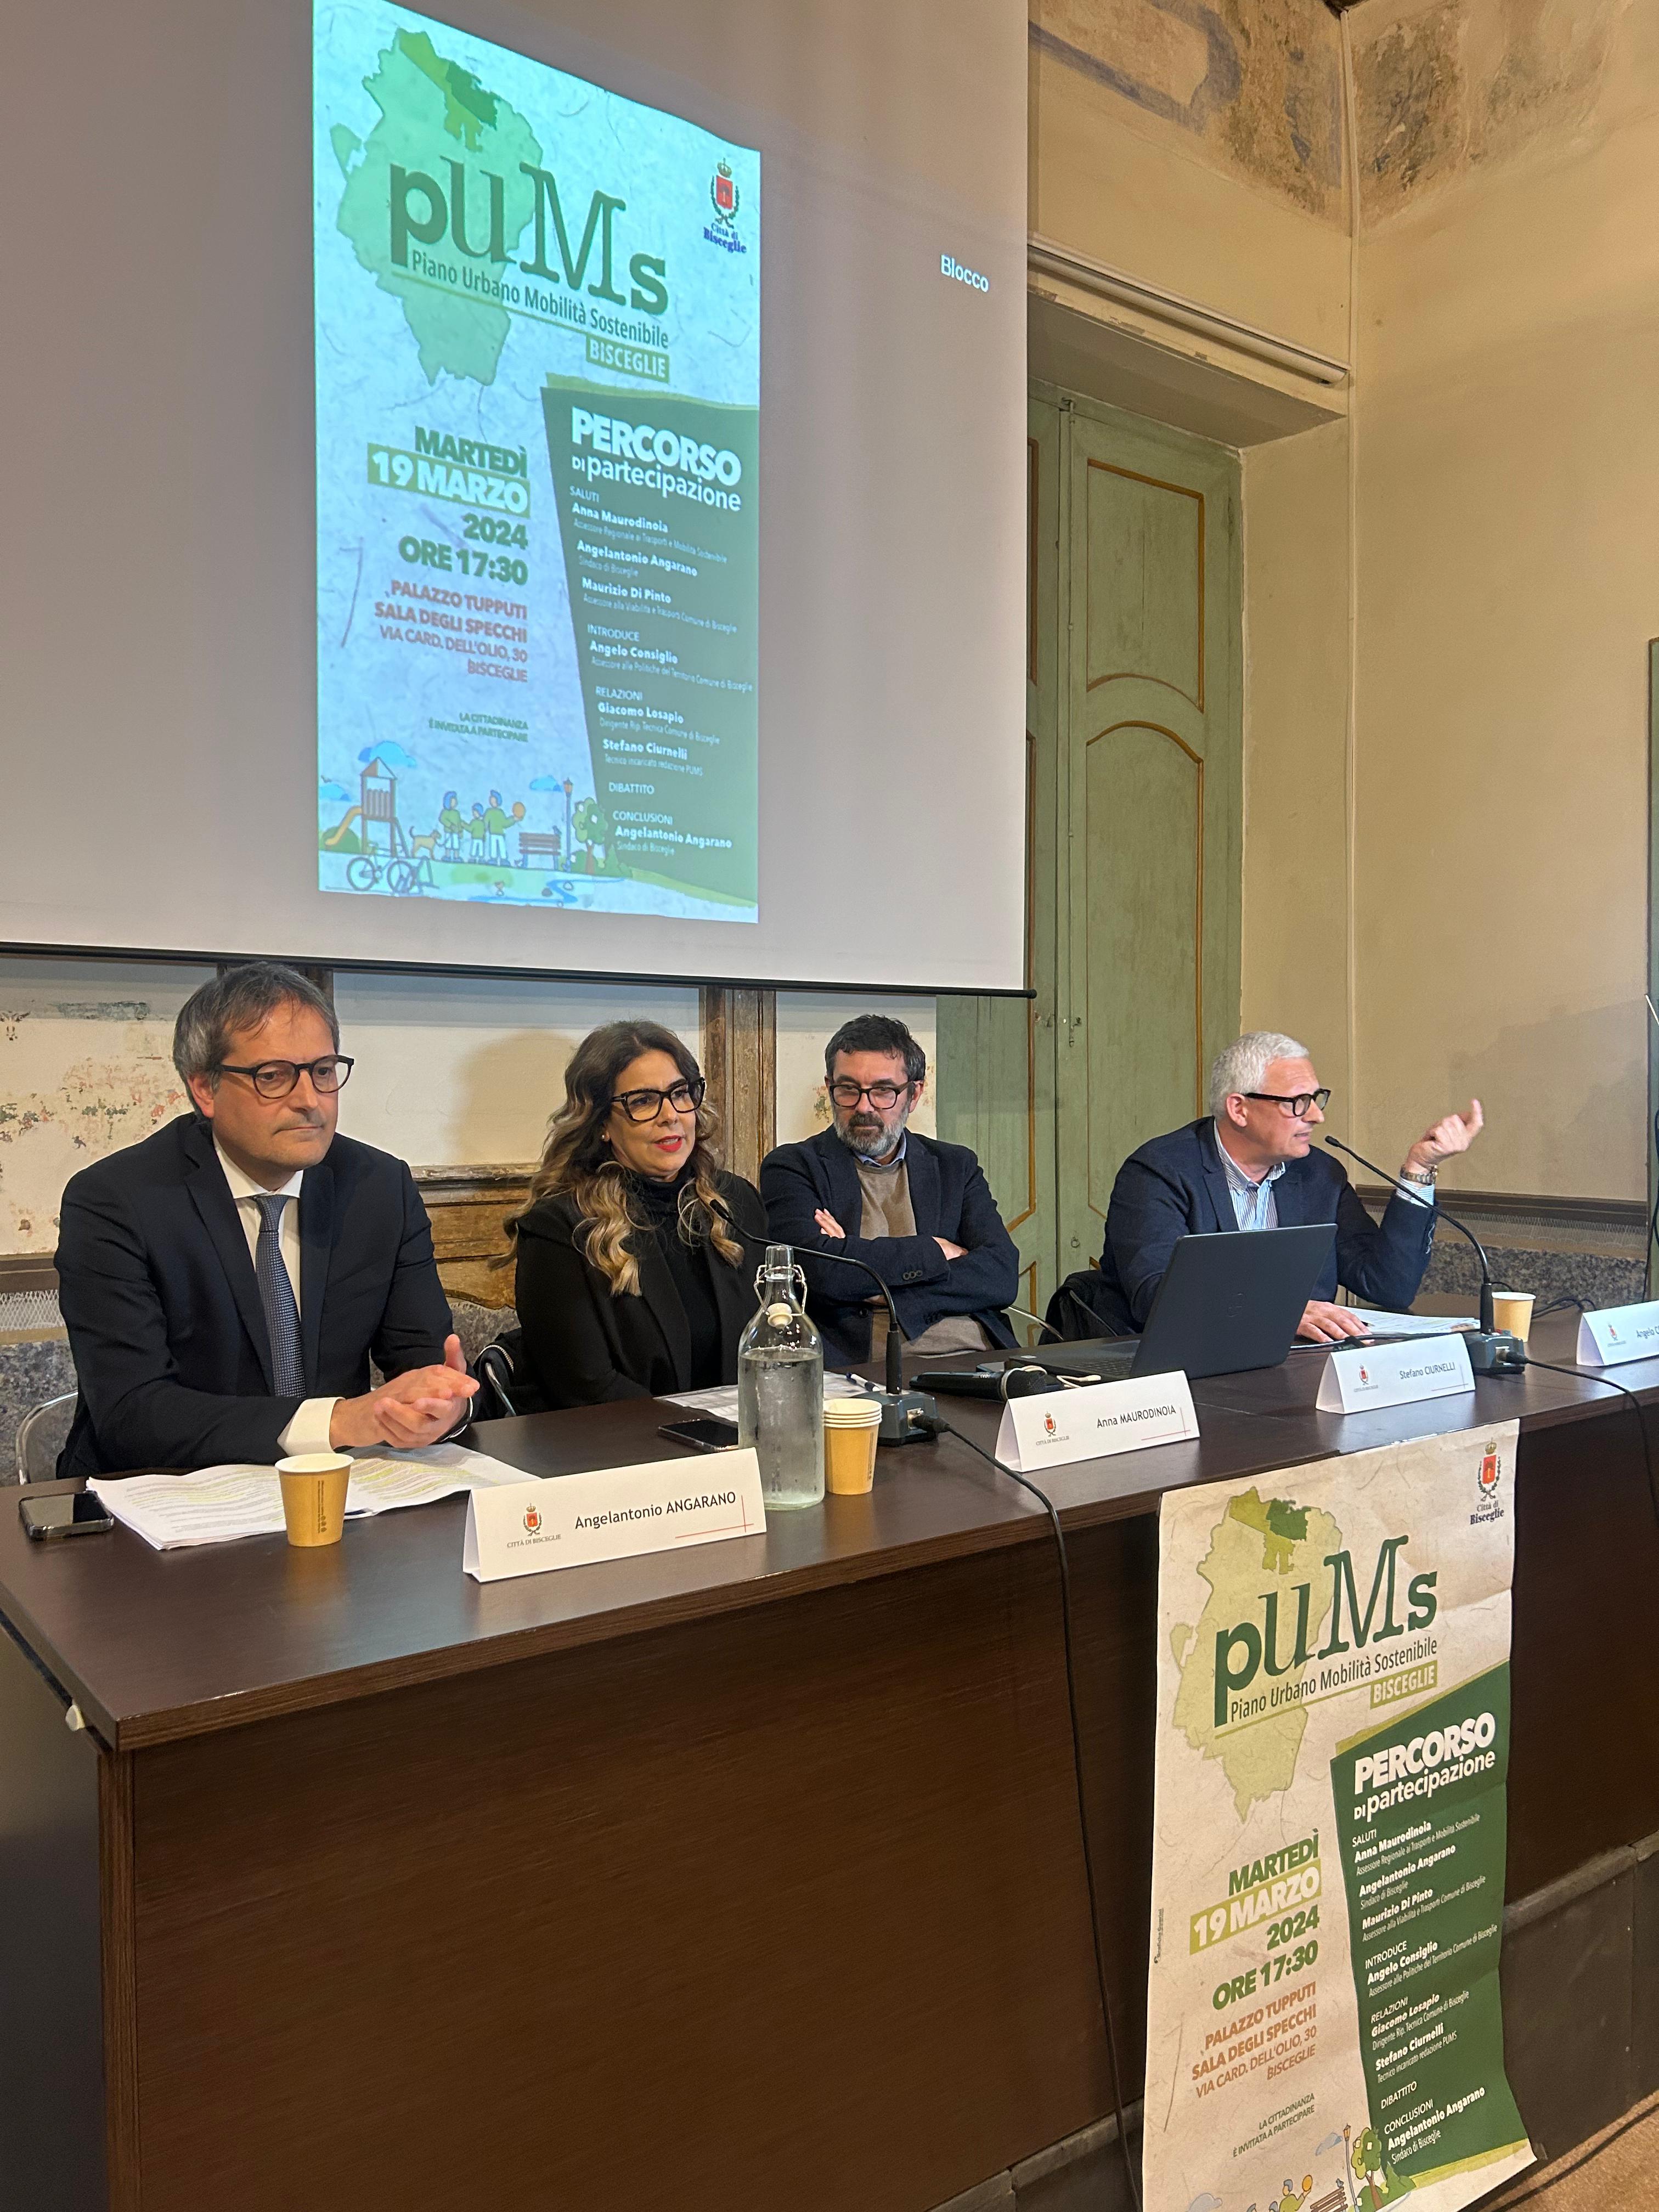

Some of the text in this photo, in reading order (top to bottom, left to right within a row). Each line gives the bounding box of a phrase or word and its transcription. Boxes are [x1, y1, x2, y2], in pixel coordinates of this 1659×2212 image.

[941, 255, 989, 292] Blocco
[413, 250, 669, 349] Piano Urbano Mobilità Sostenibile
[590, 338, 665, 379] BISCEGLIE
[415, 426, 527, 478] MARTEDÌ
[572, 407, 741, 486] PERCORSO
[373, 452, 528, 513] 19 MARZO
[569, 486, 599, 503] SALUTI
[588, 455, 741, 511] partecipazione
[463, 513, 528, 549] 2024
[572, 503, 668, 533] Anna Maurodinoia
[398, 535, 528, 585] ORE 17:30
[577, 540, 648, 564] Angelantonio
[651, 555, 697, 576] Angarano
[391, 579, 527, 620] PALAZZO TUPPUTI
[582, 577, 672, 603] Maurizio Di Pinto
[375, 601, 527, 643] SALA DEGLI SPECCHI
[588, 624, 639, 641] INTRODUCE
[380, 625, 403, 641] VIA
[512, 648, 527, 663] 30
[590, 640, 678, 664] Angelo Consiglio
[468, 658, 527, 682] BISCEGLIE
[596, 686, 643, 701] RELAZIONI
[598, 702, 684, 724] Giacomo Losapio
[603, 739, 687, 760] Stefano Ciurnelli
[608, 782, 654, 794] DIBATTITO
[613, 811, 673, 825] CONCLUSIONI
[616, 826, 732, 849] Angelantonio Angarano
[1637, 1328, 1655, 1339] Angelo
[1400, 1362, 1455, 1379] Stefano CIURNELLI
[1097, 1405, 1176, 1428] Anna MAURODINOIA
[575, 1492, 736, 1530] Angelantonio ANGARANO
[1470, 1508, 1504, 1525] Bisceglie
[1477, 1503, 1491, 1512] Città
[507, 1539, 524, 1548] CITTÀ
[533, 1534, 561, 1544] BISCEGLIE
[1231, 1637, 1437, 1722] Piano Urbano Mobilità Sostenibile
[1374, 1665, 1434, 1703] BISCEGLIE
[1355, 1712, 1496, 1795] PERCORSO
[1367, 1751, 1496, 1822] partecipazione
[1352, 1829, 1376, 1847] SALUTI
[1355, 1846, 1378, 1863] Anna
[1379, 1821, 1431, 1852] Maurodinoia
[1229, 1827, 1319, 1897] MARTEDÌ
[1359, 1845, 1455, 1897] Angelantonio Angarano
[1194, 1908, 1227, 1946] 19
[1230, 1866, 1321, 1932] MARZO
[1363, 1904, 1400, 1929] Maurizio
[1401, 1897, 1410, 1910] Di
[1412, 1889, 1433, 1905] Pinto
[1267, 1904, 1320, 1951] 2024
[1365, 1940, 1407, 1970] INTRODUCE
[1367, 1962, 1398, 1985] Angelo
[1400, 1942, 1437, 1967] Consiglio
[1212, 1940, 1318, 2010] ORE 17:30
[1205, 1981, 1316, 2050] PALAZZO TUPPUTI
[1371, 1997, 1408, 2023] RELAZIONI
[1372, 1994, 1440, 2036] Giacomo Losapio
[1192, 2004, 1316, 2081] SALA DEGLI SPECCHI
[1196, 2025, 1316, 2098] VIA CARD. DELL'OLIO, 30
[1376, 2022, 1443, 2071] Stefano Ciurnelli
[1267, 2044, 1316, 2080] BISCEGLIE
[1259, 2093, 1314, 2130] LA CITTADINANZA
[1381, 2081, 1417, 2109] DIBATTITO
[1239, 2132, 1267, 2155] INVITATA
[1268, 2129, 1273, 2137] A
[1274, 2104, 1314, 2134] PARTECIPARE
[1384, 2099, 1434, 2135] CONCLUSIONI
[1388, 2087, 1485, 2151] Angelantonio Angarano
[1391, 2130, 1441, 2165] Sindaco di Bisceglie
